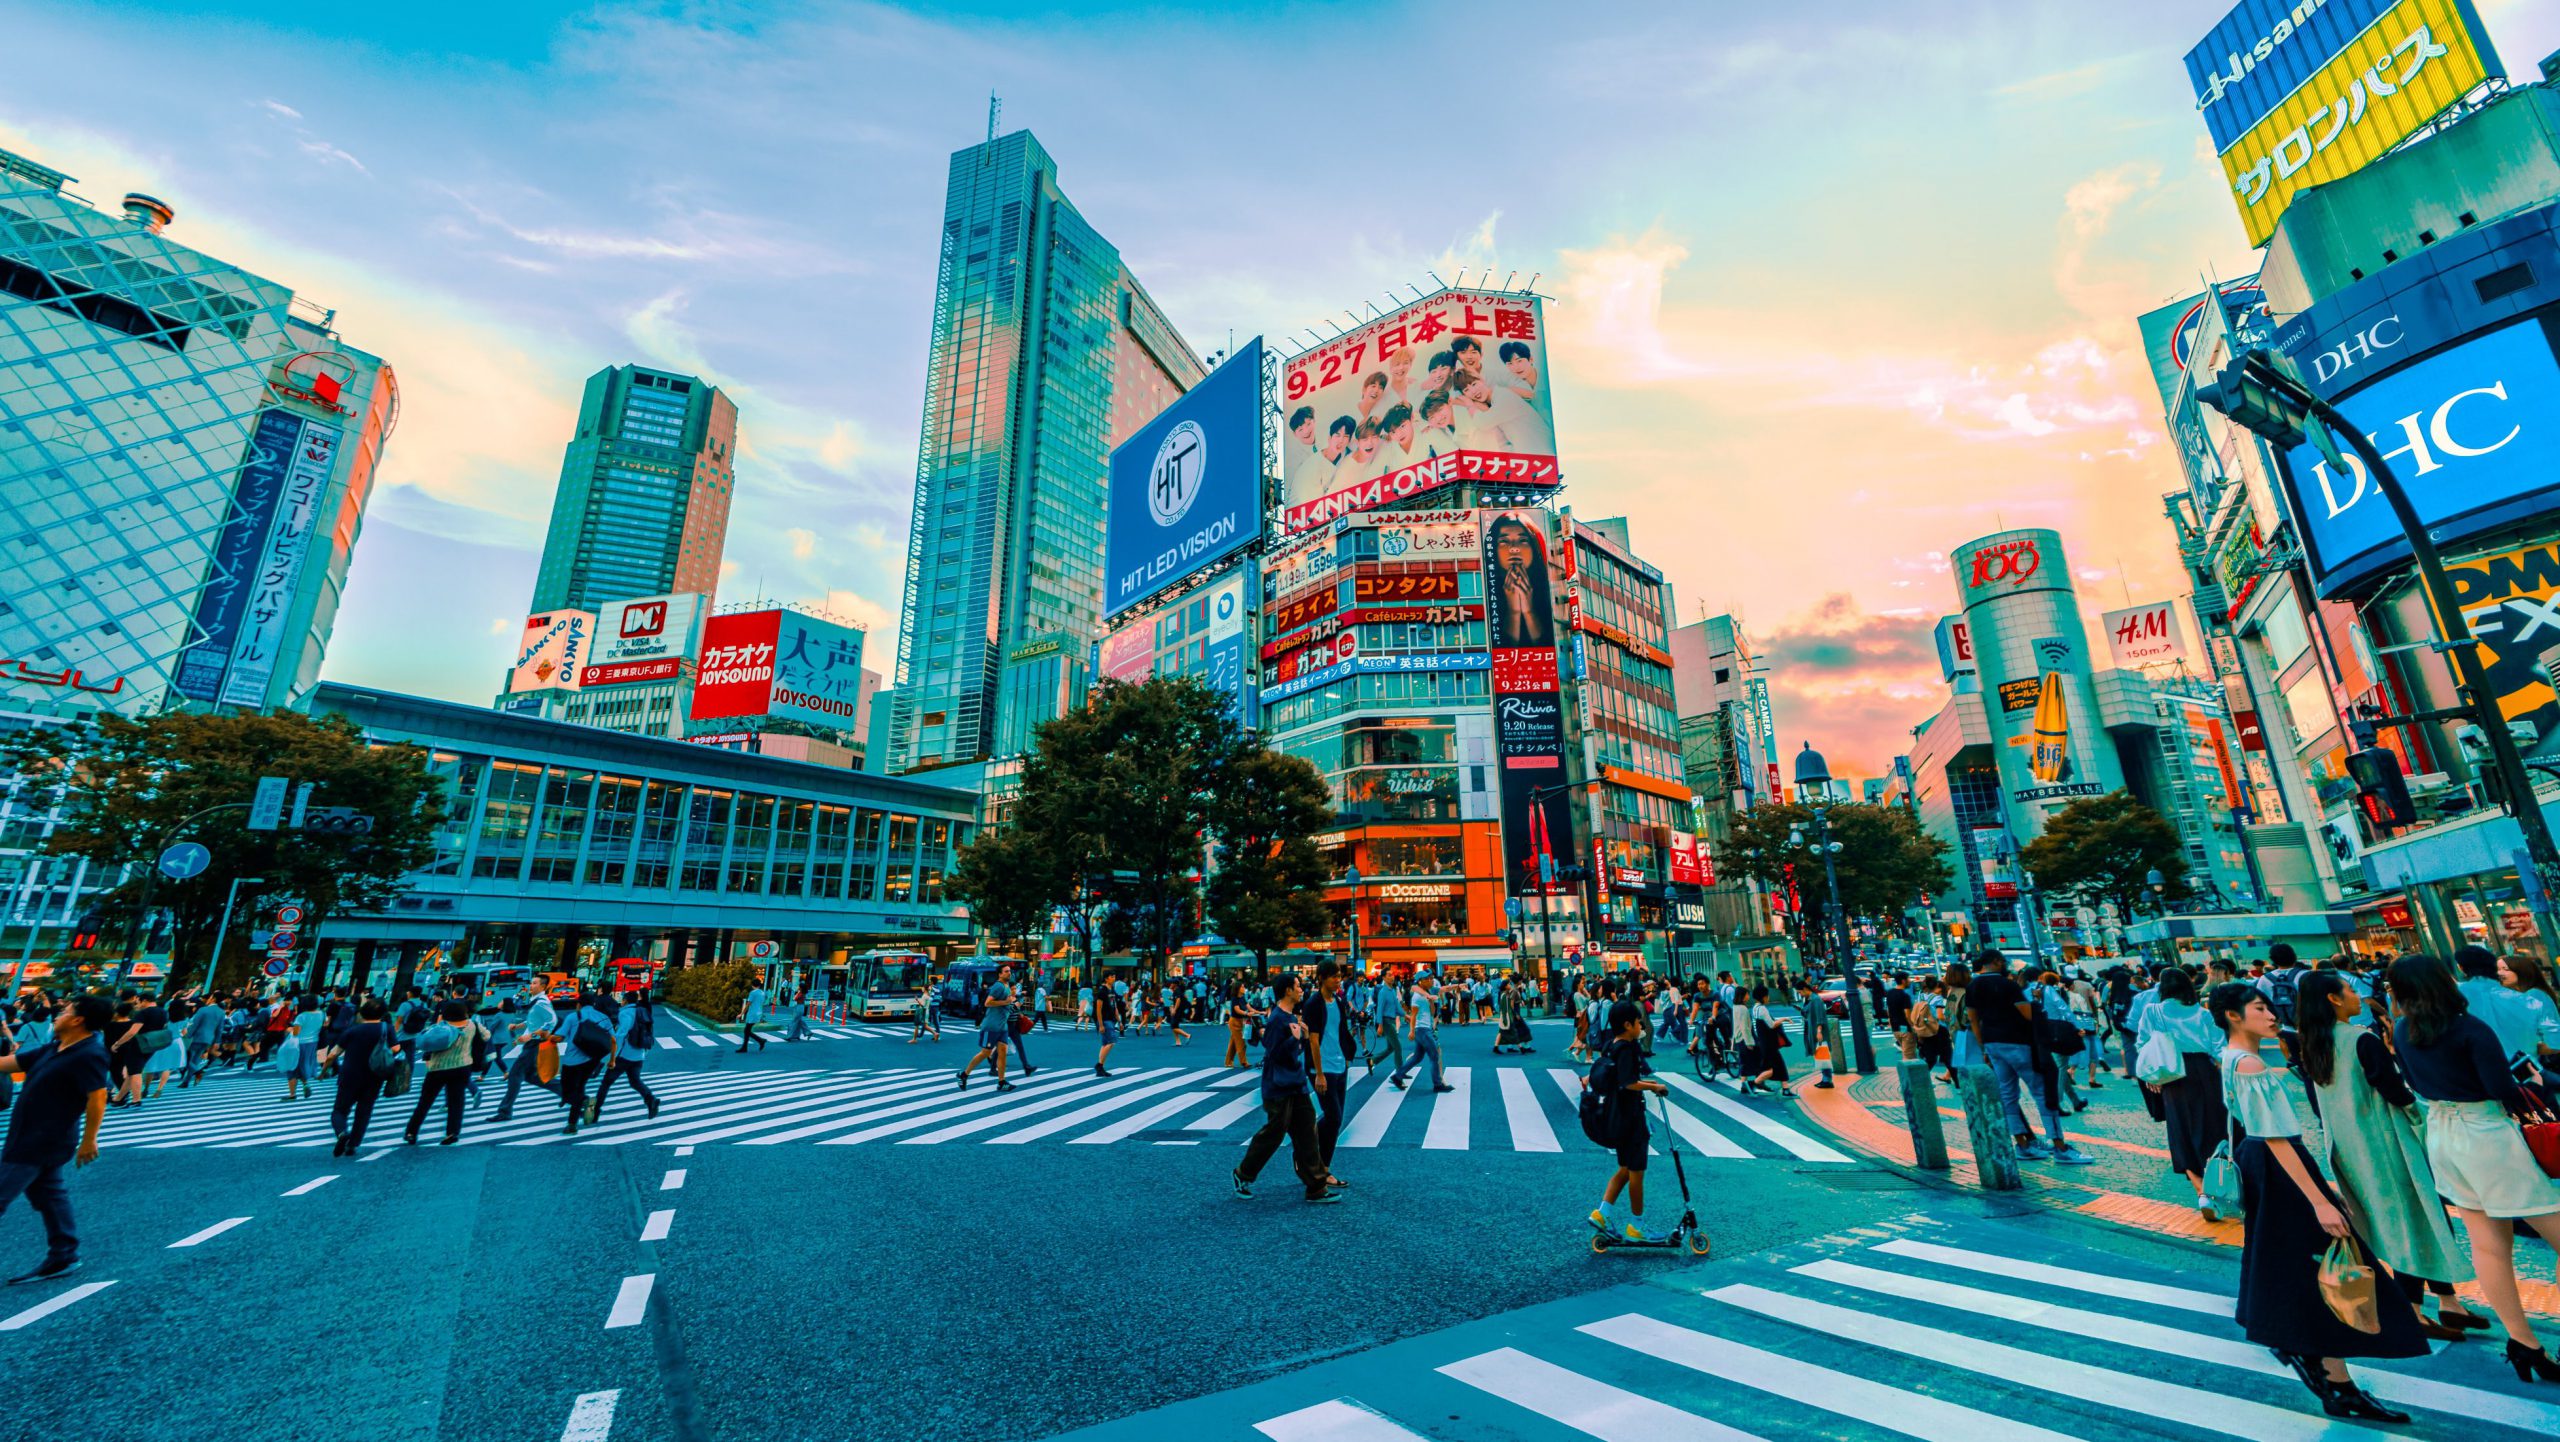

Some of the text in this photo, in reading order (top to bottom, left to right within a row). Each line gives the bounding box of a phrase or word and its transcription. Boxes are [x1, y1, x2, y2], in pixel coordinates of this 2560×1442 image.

[2235, 23, 2447, 207] サロンパス
[2312, 314, 2404, 384] DHC
[2311, 380, 2521, 520] DHC
[1463, 455, 1553, 477] ワナワン
[1367, 510, 1473, 525] しゃぶしゃぶバイキング
[1413, 530, 1475, 550] しゃぶ葉
[1975, 540, 2034, 559] SHIBUYA
[1121, 512, 1236, 596] HIT LED VISION
[239, 473, 314, 661] ワコールビッグバザール
[1969, 547, 2040, 588] 109
[1265, 579, 1276, 593] 9F
[1356, 576, 1455, 595] コンタクト
[622, 604, 662, 634] DC
[1279, 591, 1337, 628] プライス
[1425, 606, 1473, 624] ガスト
[1571, 606, 1579, 627] ガスト
[1311, 617, 1342, 641] ガスト
[2115, 608, 2167, 645] H&M
[517, 619, 567, 668] SANKYO
[560, 617, 585, 682] SANKYO
[607, 644, 667, 659] DC MasterCard
[616, 639, 630, 649] DC
[631, 637, 650, 647] VISA
[780, 628, 861, 671] 大声
[2126, 648, 2160, 658] 150m
[702, 642, 774, 670] カラオケ
[1297, 646, 1334, 676] ガスト
[1362, 655, 1488, 669] AEON 英会話イーオン
[1494, 649, 1554, 666] ユリゴコロ
[605, 663, 673, 679] 三菱東京UFJ銀行
[699, 666, 772, 686] JOYSOUND
[1264, 666, 1278, 682] 7F
[1285, 669, 1338, 694] 英会話イーオン
[773, 687, 854, 717] JOYSOUND
[1499, 697, 1557, 719] Rihwa
[1756, 683, 1773, 737] BIC CAMERA
[2009, 699, 2035, 709] パワー
[1504, 720, 1555, 731] 9.20 Release
[2242, 725, 2258, 736] JTB
[693, 735, 718, 744] カラオケ
[2010, 736, 2028, 745] NEW
[2036, 745, 2062, 762] BIG
[2015, 784, 2102, 800] MAYBELLINE
[1675, 851, 1694, 867] アコム
[1381, 884, 1451, 897] L'OCCITANE
[1677, 903, 1706, 923] LUSH
